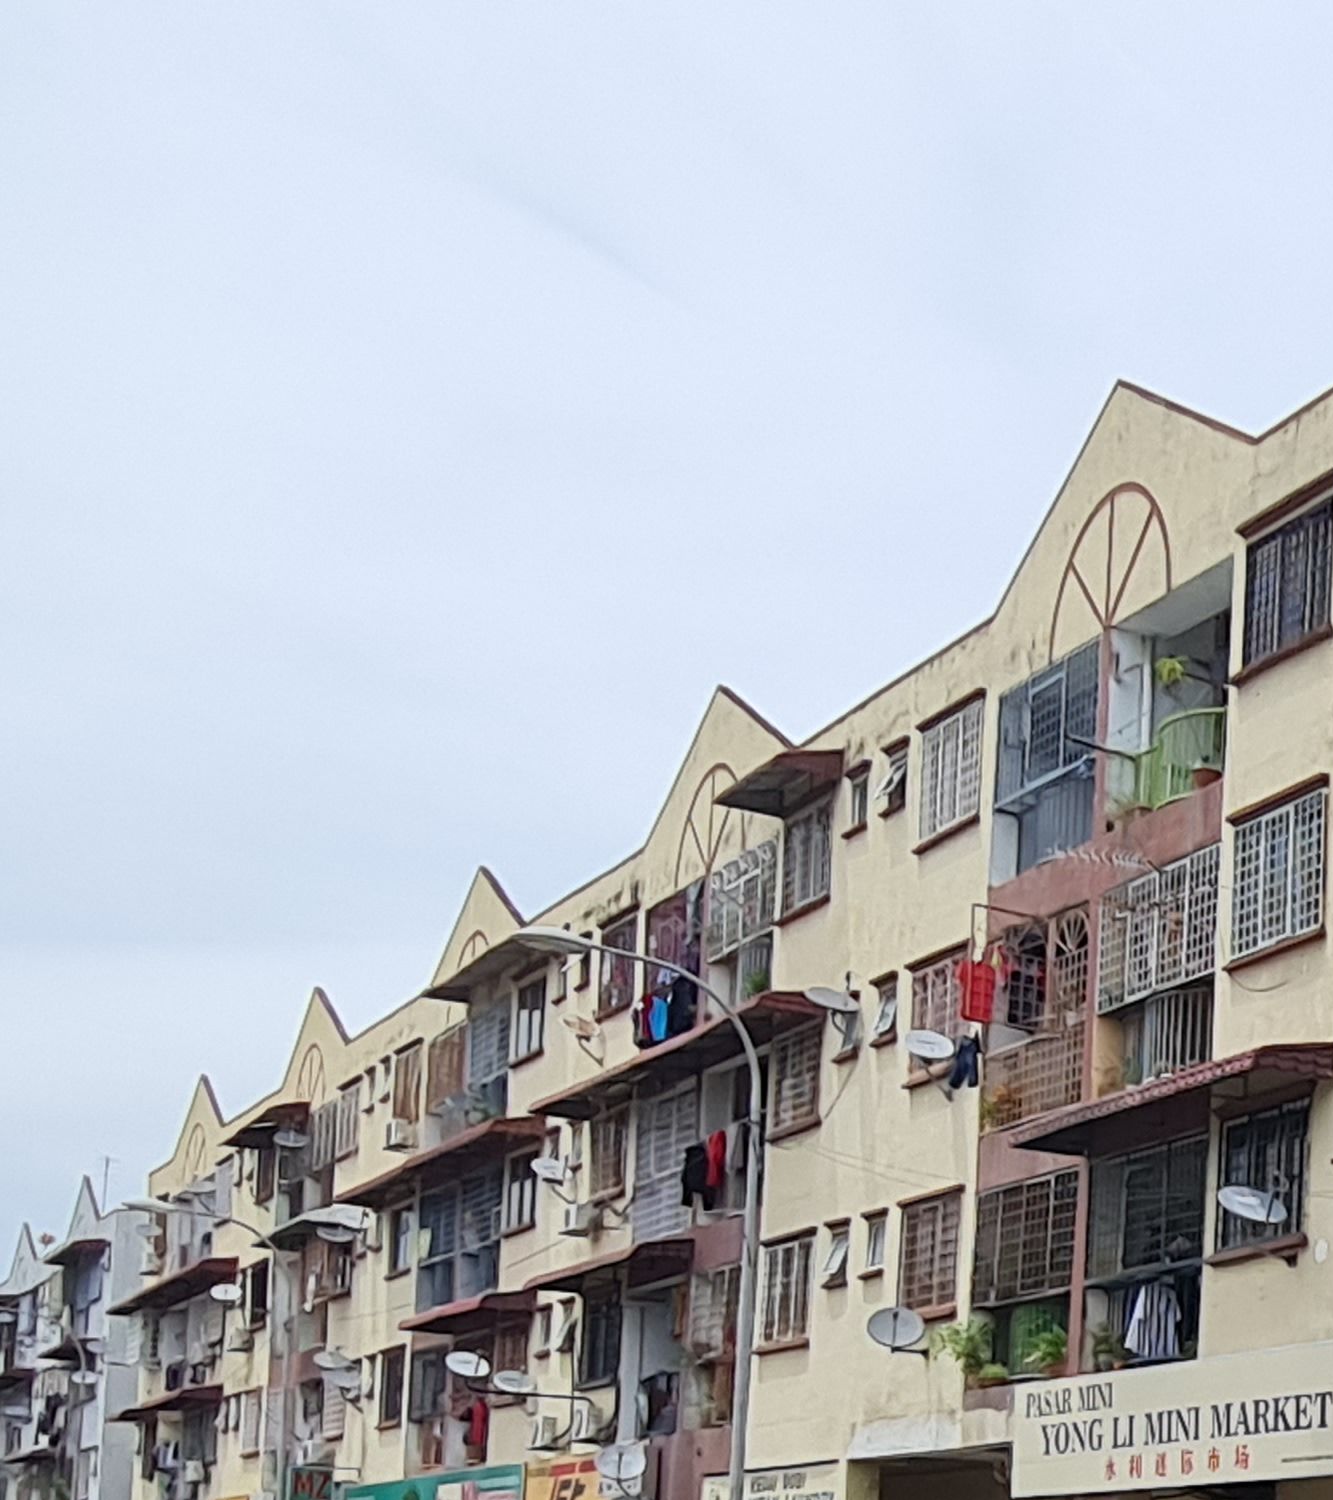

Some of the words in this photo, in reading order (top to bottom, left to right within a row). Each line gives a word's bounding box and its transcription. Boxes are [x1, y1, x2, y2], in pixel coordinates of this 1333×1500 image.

[1026, 1387, 1072, 1418] PASAR
[1078, 1383, 1114, 1411] MINI
[1041, 1417, 1104, 1456] YONG
[1111, 1415, 1136, 1449] LI
[1143, 1406, 1200, 1446] MINI
[1210, 1391, 1333, 1440] MARKET
